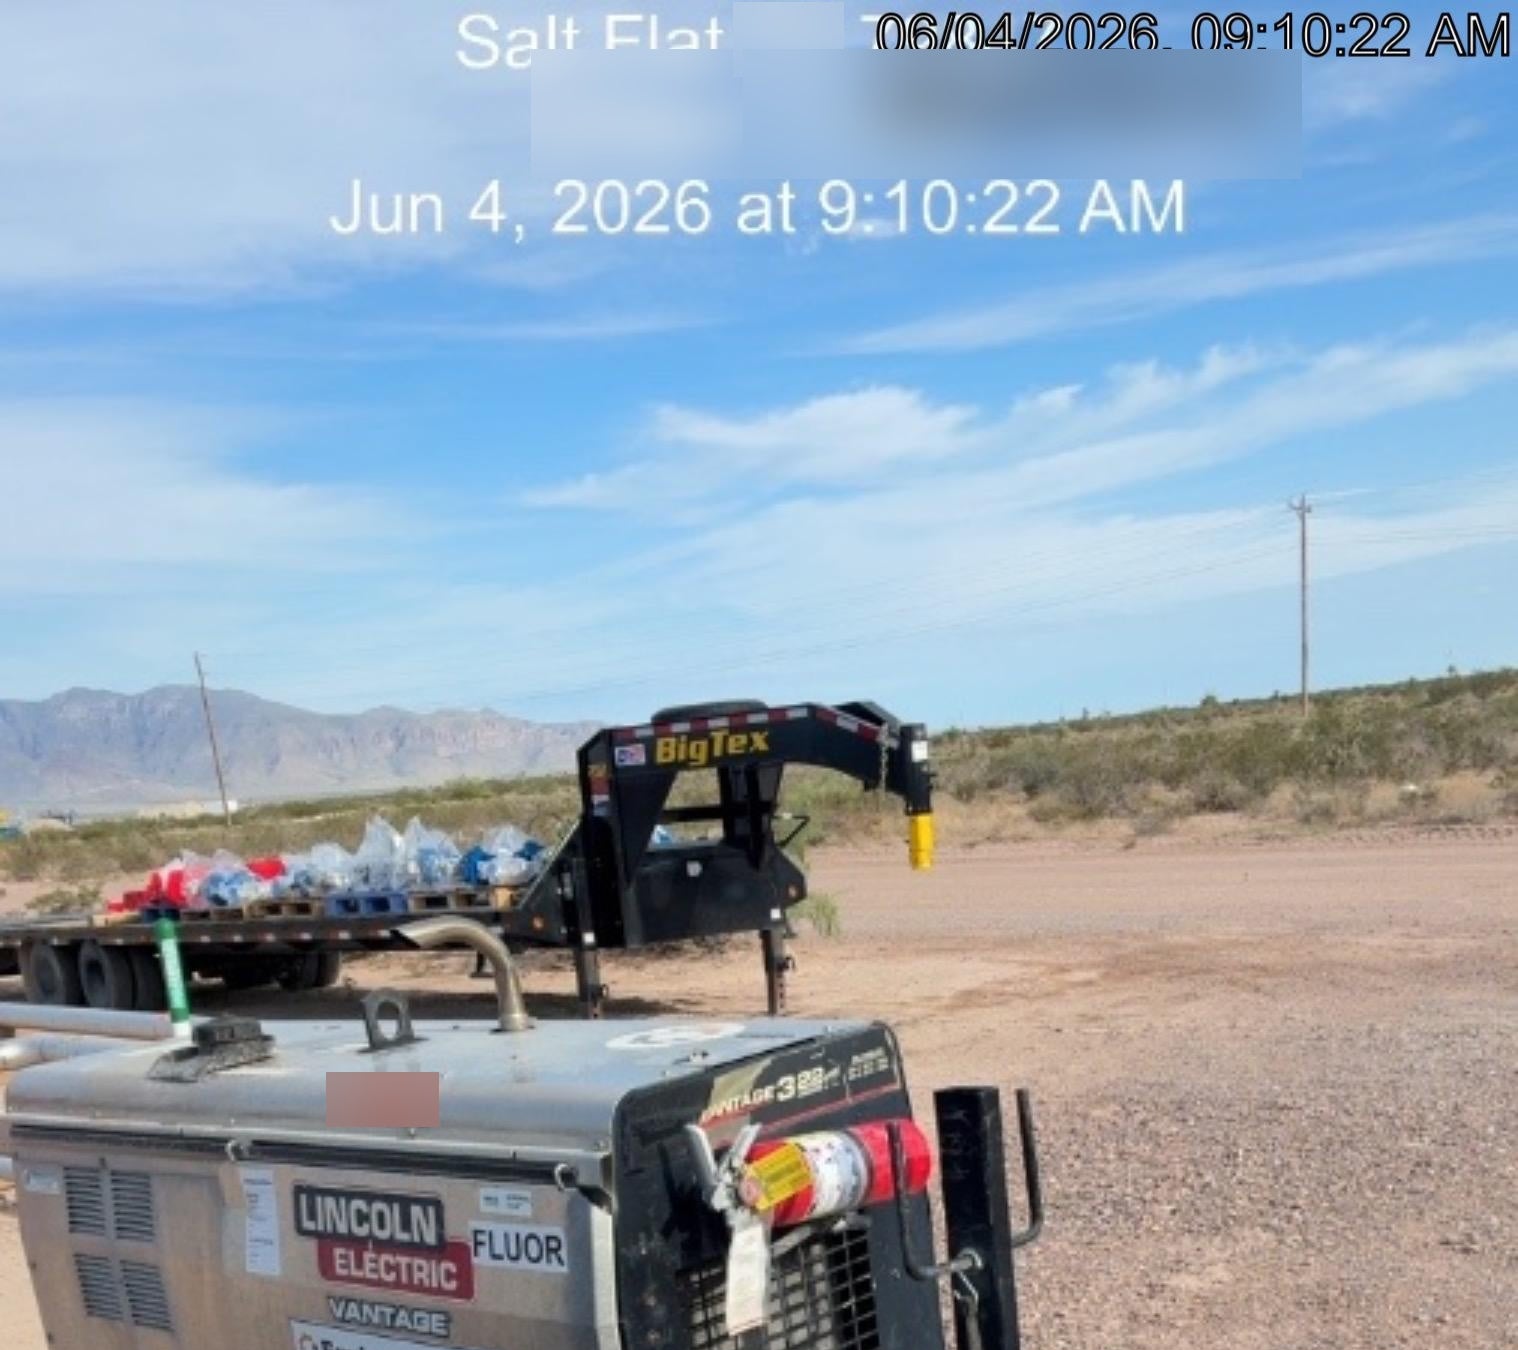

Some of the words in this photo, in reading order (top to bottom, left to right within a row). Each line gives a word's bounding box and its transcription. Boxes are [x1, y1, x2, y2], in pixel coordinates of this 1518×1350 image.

[299, 1192, 438, 1247] LINCOLN
[472, 1228, 566, 1267] FLUOR
[333, 1247, 459, 1292] ELECTRIC
[328, 1297, 450, 1337] VANTAGE
